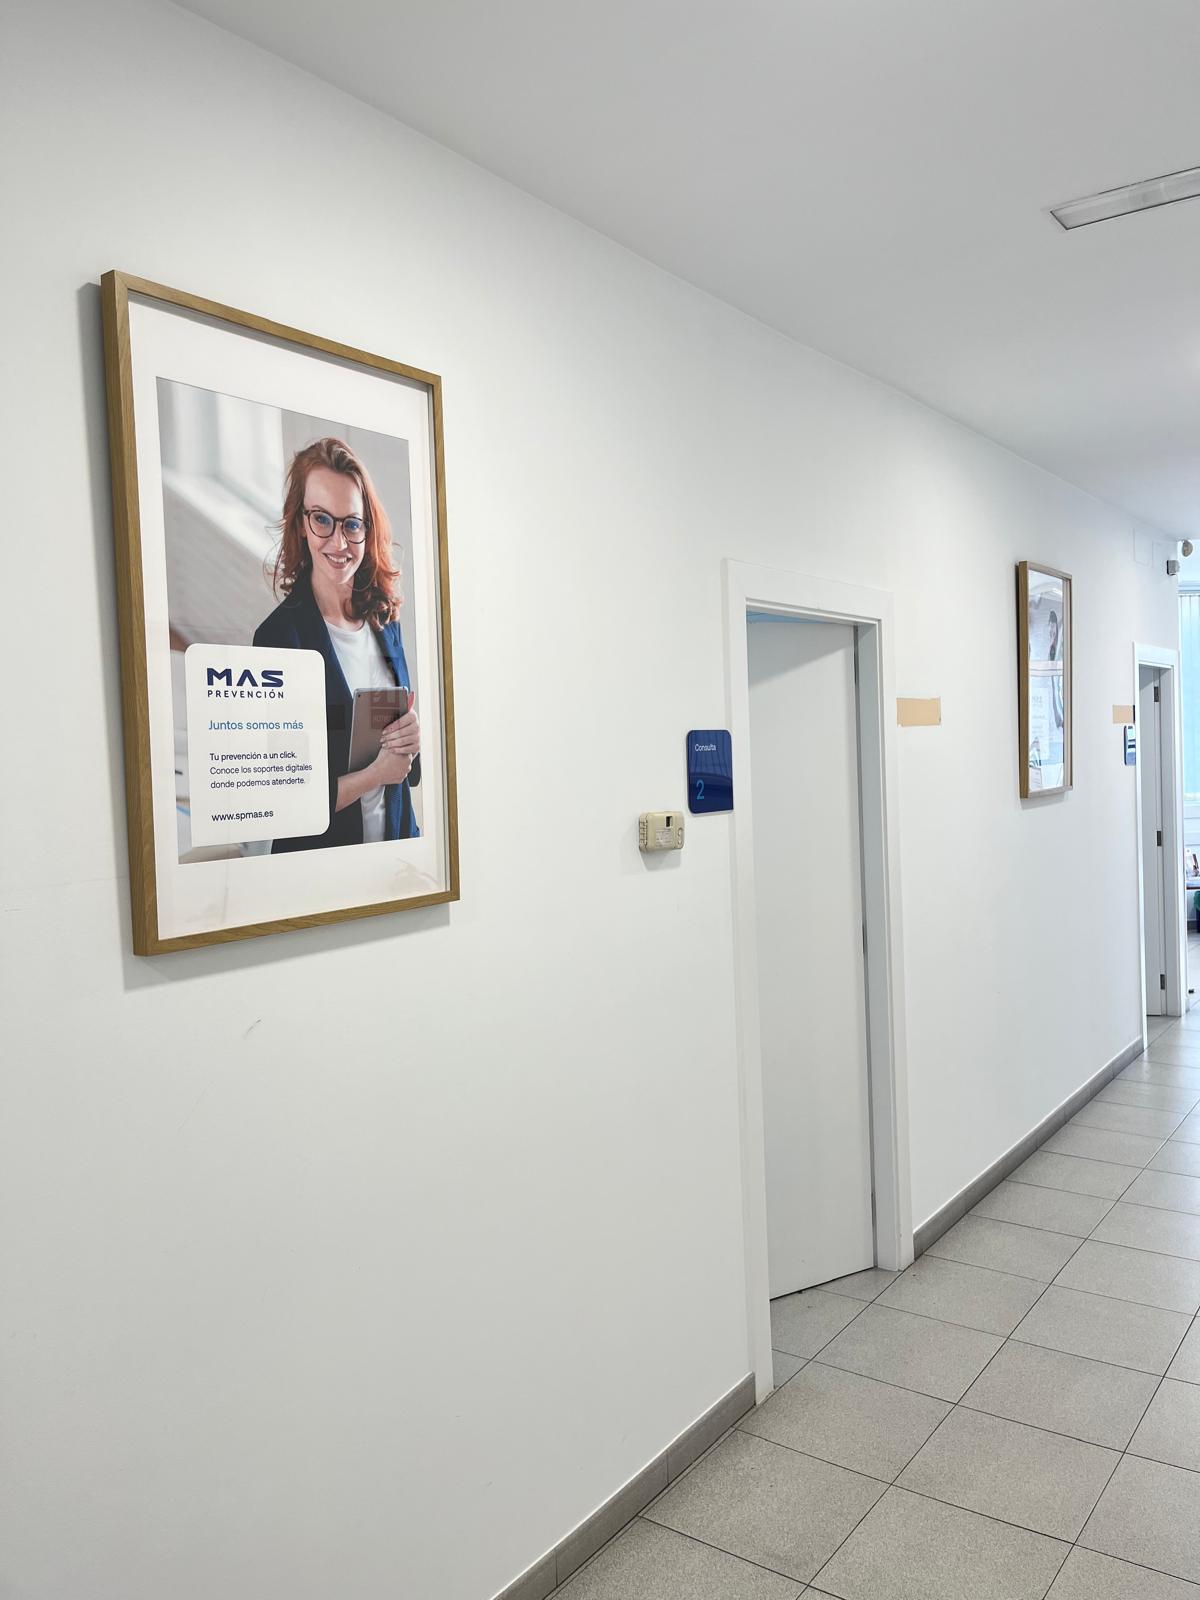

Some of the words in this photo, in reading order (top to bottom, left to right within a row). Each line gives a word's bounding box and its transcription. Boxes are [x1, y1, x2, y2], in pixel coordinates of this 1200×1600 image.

[207, 689, 284, 699] PREVENCIÓN
[208, 720, 244, 730] Juntos
[246, 721, 280, 730] somos
[282, 720, 304, 730] más
[694, 743, 717, 751] Consulta
[209, 753, 219, 761] Tu
[221, 752, 262, 762] prevención
[279, 751, 297, 759] click.
[209, 767, 239, 775] Conoce
[241, 766, 252, 774] los
[253, 765, 284, 775] soportes
[285, 763, 313, 773] digitales
[210, 780, 235, 789] donde
[236, 779, 270, 789] podemos
[271, 777, 306, 786] atenderte.
[696, 779, 705, 800] 2
[211, 811, 274, 822] www.spmas.es
